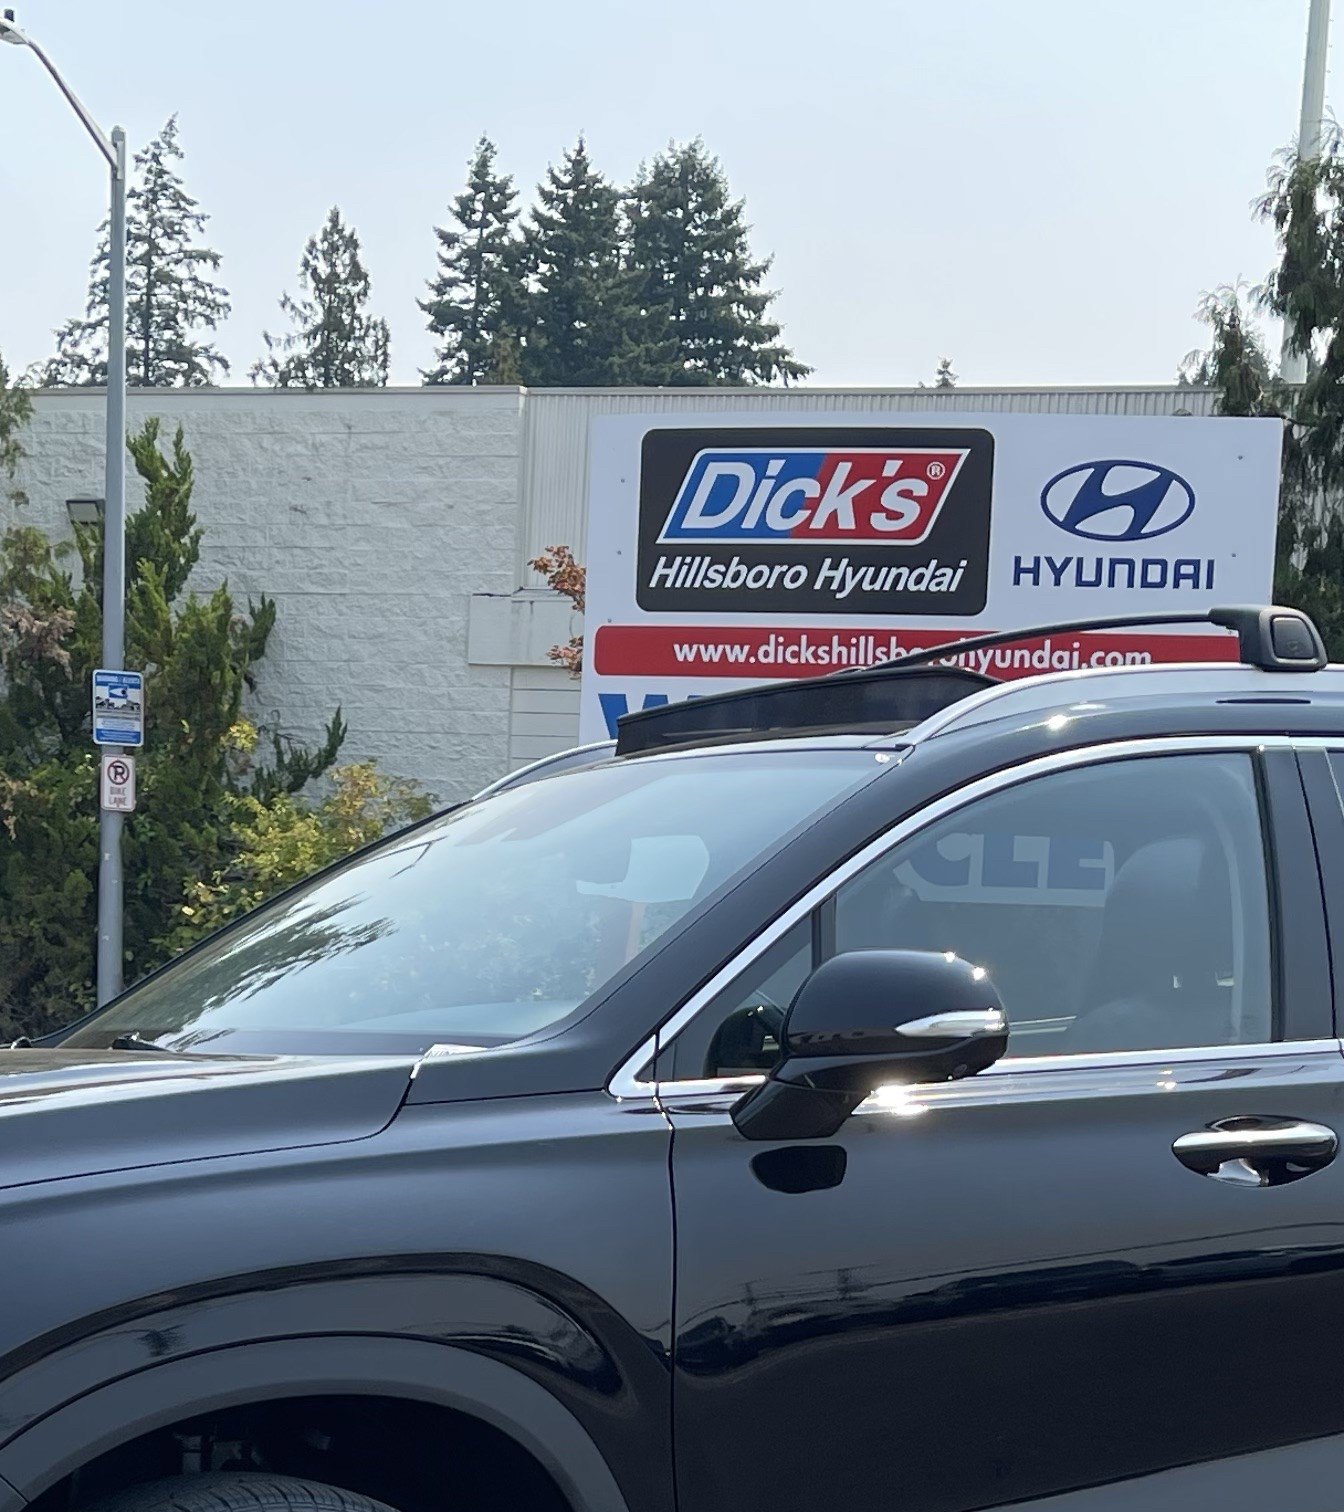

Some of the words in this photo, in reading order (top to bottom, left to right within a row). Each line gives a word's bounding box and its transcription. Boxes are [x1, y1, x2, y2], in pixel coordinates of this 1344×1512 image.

[681, 459, 928, 531] Dick's
[649, 556, 807, 589] Hillsboro
[813, 558, 967, 599] Hyundai
[1014, 555, 1214, 590] HYUNDAI
[673, 633, 1153, 674] www.dickshillsbohyundai.com
[108, 796, 127, 806] LANE
[109, 786, 127, 796] BIKE
